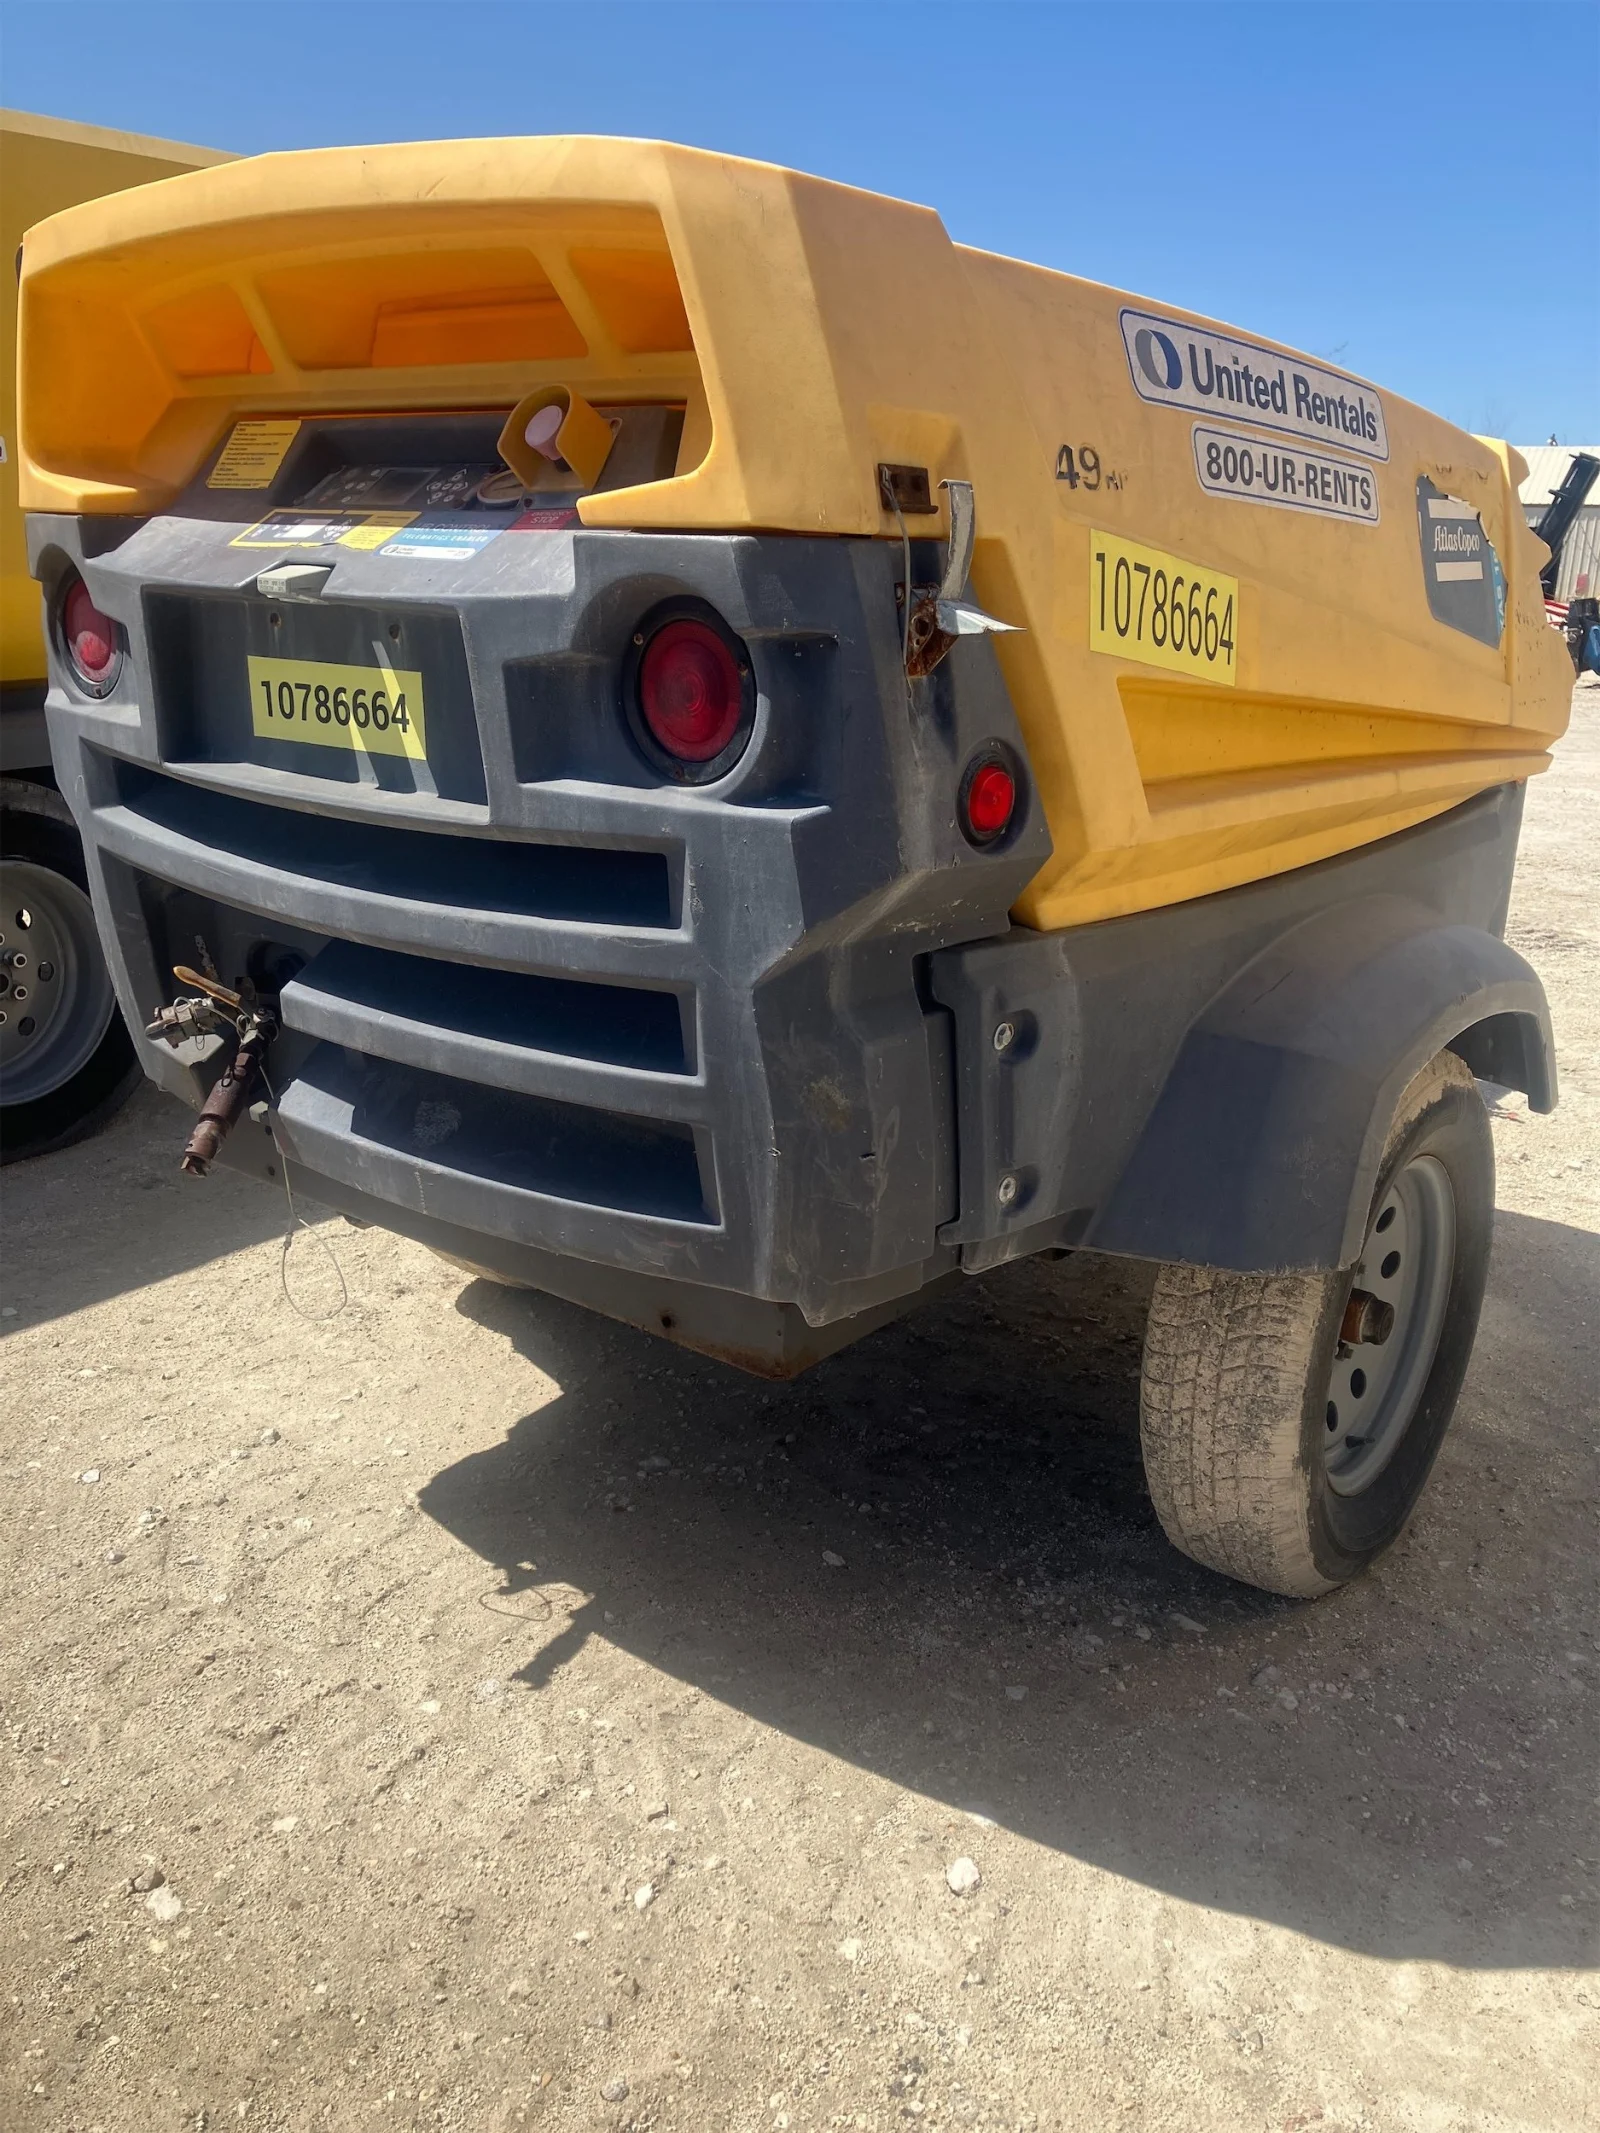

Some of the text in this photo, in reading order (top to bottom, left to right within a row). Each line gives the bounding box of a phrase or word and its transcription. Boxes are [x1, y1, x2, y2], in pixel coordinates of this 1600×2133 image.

[1188, 343, 1378, 442] United Rentals
[1056, 444, 1100, 490] 49
[1206, 442, 1372, 511] 800-UR-RENTS
[402, 533, 449, 542] TELEMATICS
[530, 516, 560, 525] STOP
[1096, 552, 1234, 666] 10786664
[261, 681, 410, 733] 10786664
